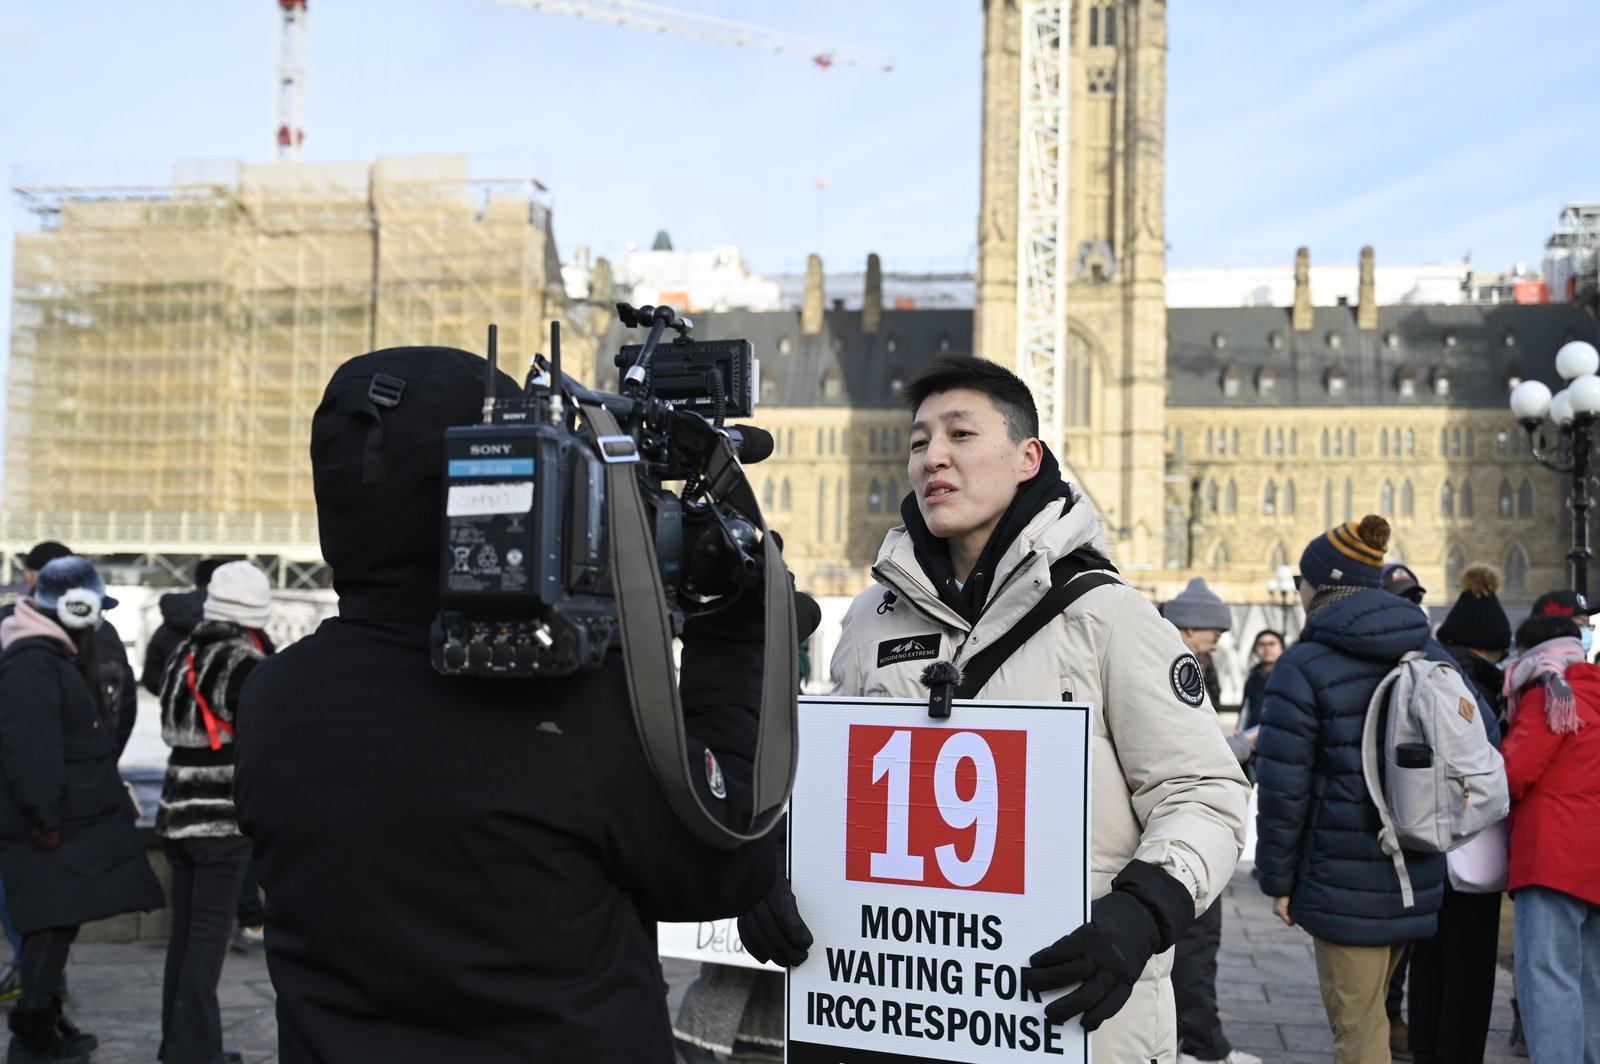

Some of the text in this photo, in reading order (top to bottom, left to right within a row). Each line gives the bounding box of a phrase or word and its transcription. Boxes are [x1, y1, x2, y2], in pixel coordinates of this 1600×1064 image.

[502, 412, 527, 420] SONY
[470, 444, 512, 455] SONY
[880, 649, 936, 664] BOSIDENG EXTREME
[870, 730, 999, 887] 19
[861, 905, 1003, 950] MONTHS
[826, 948, 963, 994] WAITING
[807, 991, 1064, 1055] IRCC RESPONSE
